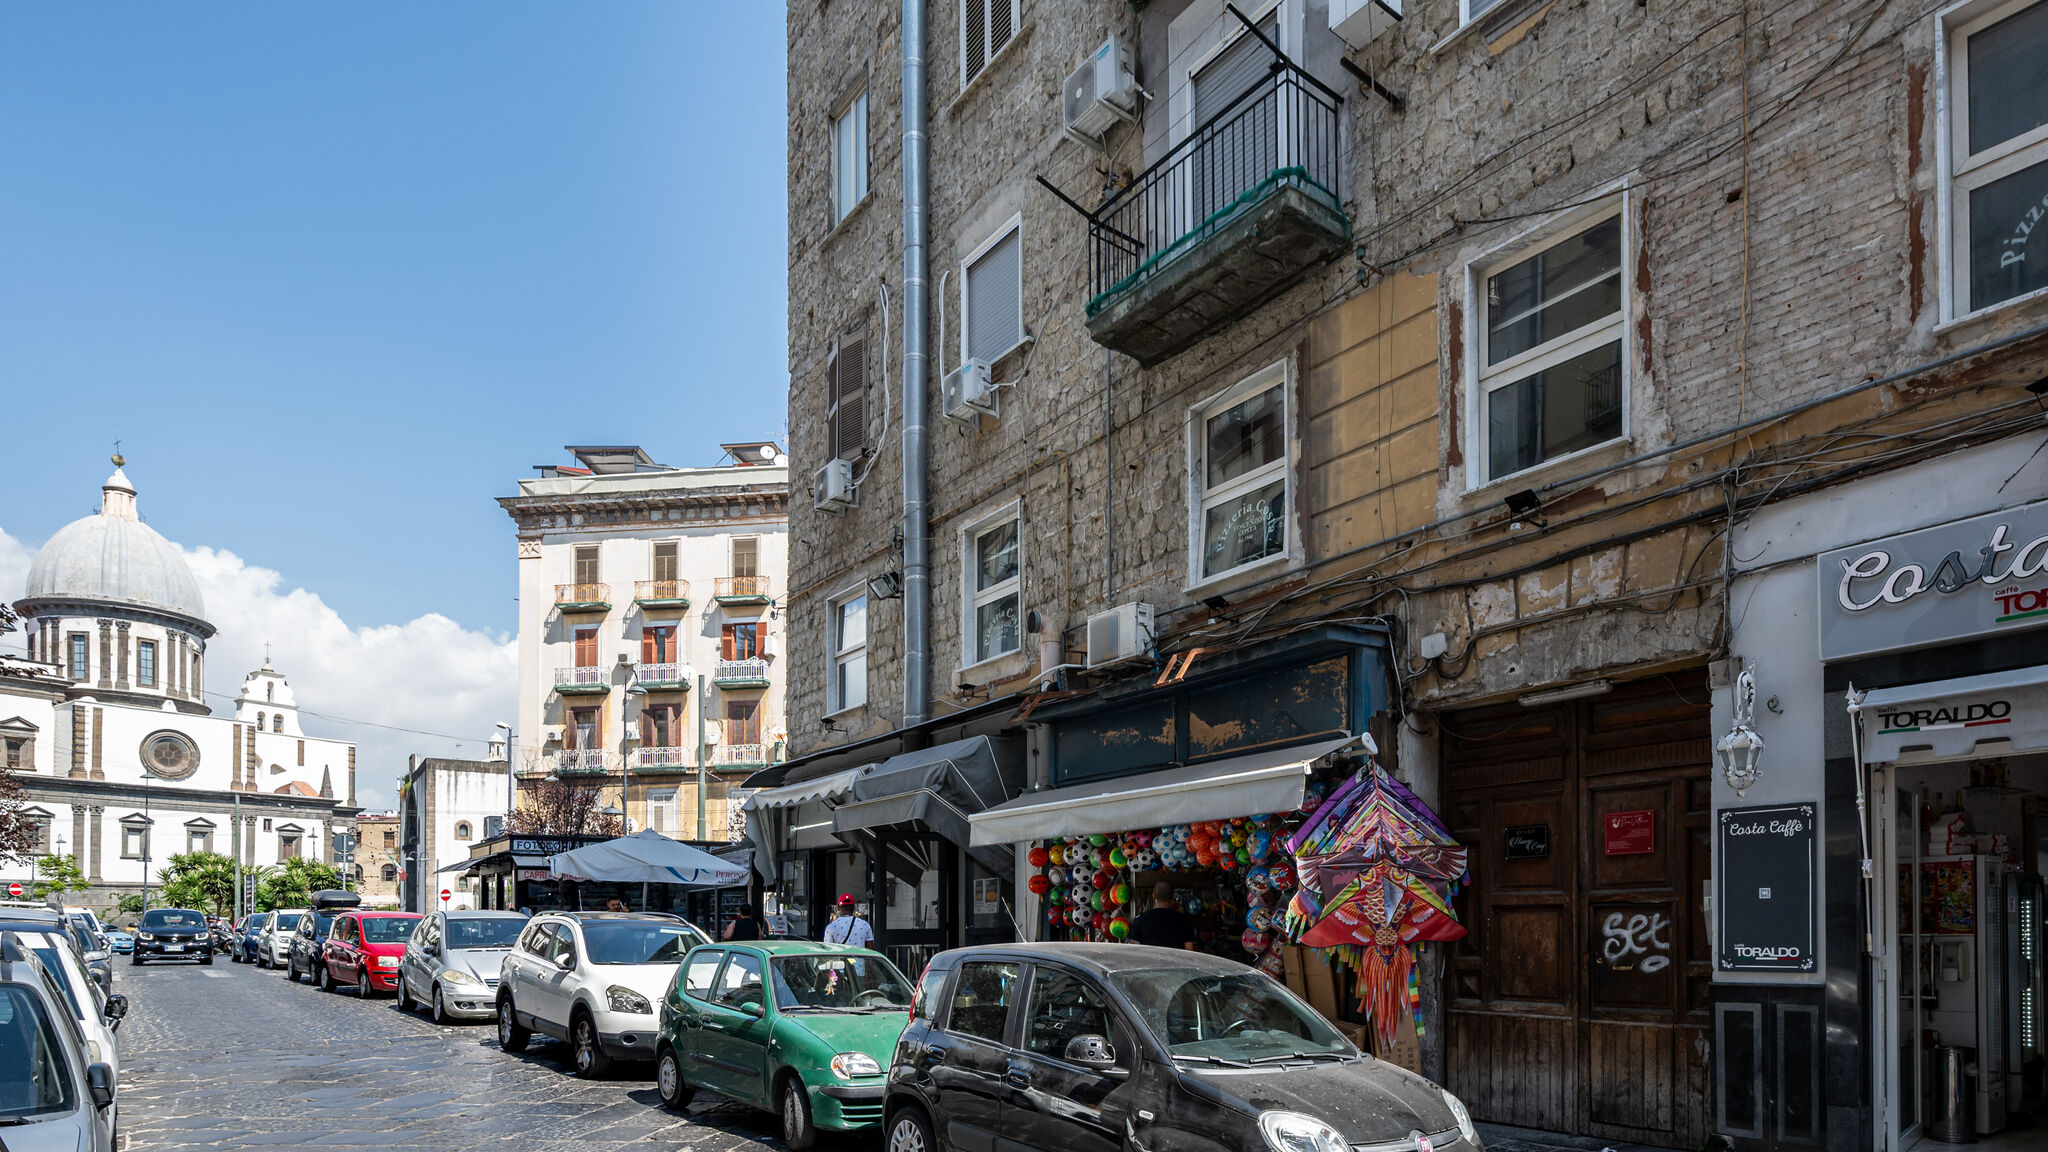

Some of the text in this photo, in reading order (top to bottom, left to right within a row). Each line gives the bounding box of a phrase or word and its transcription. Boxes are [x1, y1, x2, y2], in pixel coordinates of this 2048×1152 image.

[1839, 525, 2048, 611] Costa
[1994, 585, 2020, 596] caffè
[1878, 701, 2011, 729] TORALDO
[1730, 819, 1804, 837] Costa Caffè
[524, 871, 548, 879] CAPRI
[715, 871, 744, 879] PERONI
[1734, 946, 1800, 958] TORALDO
